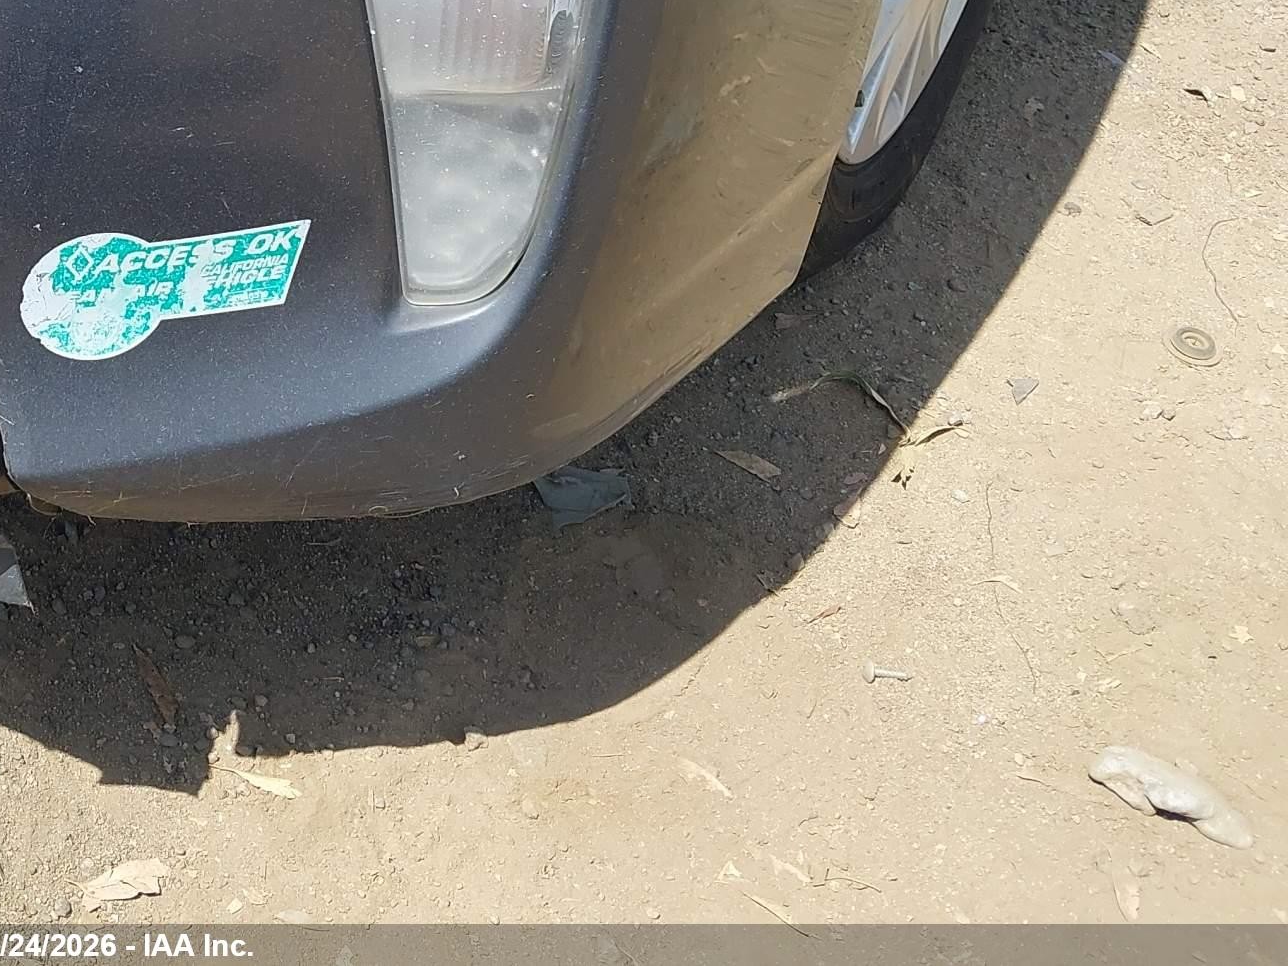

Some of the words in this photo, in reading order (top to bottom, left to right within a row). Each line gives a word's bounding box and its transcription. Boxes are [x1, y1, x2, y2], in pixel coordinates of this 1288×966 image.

[246, 230, 297, 254] OK
[200, 253, 289, 276] CALIFORNIA
[202, 265, 287, 287] EHICLE
